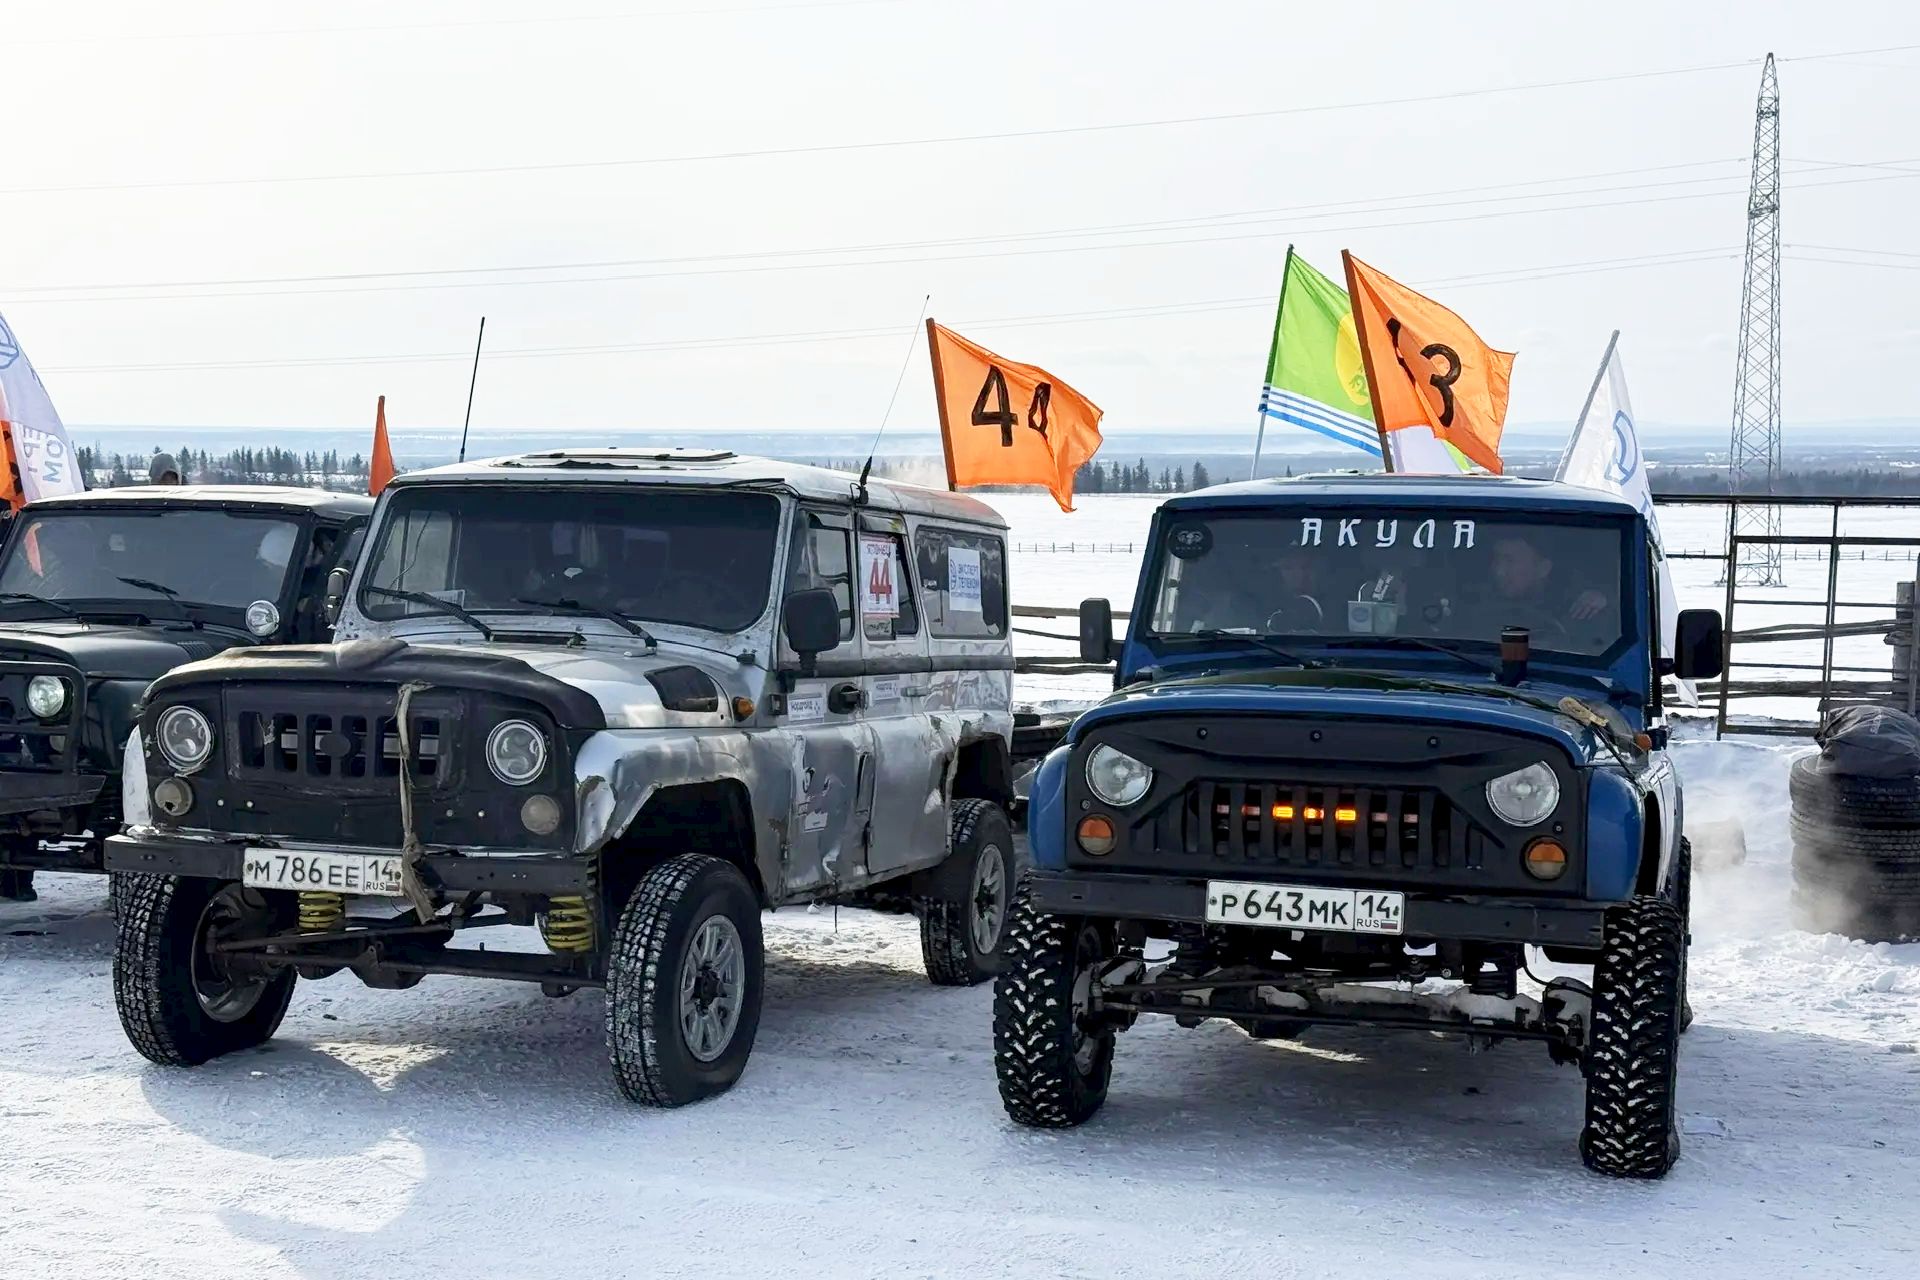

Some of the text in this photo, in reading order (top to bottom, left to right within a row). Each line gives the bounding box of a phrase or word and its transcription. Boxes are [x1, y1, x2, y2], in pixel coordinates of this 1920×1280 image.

[1301, 518, 1475, 548] АКУЛА
[869, 558, 892, 605] 44
[254, 855, 360, 888] М786ЕЕ
[365, 881, 385, 891] RUS
[1220, 889, 1391, 925] Р643МК 14
[1356, 918, 1380, 928] RUS
